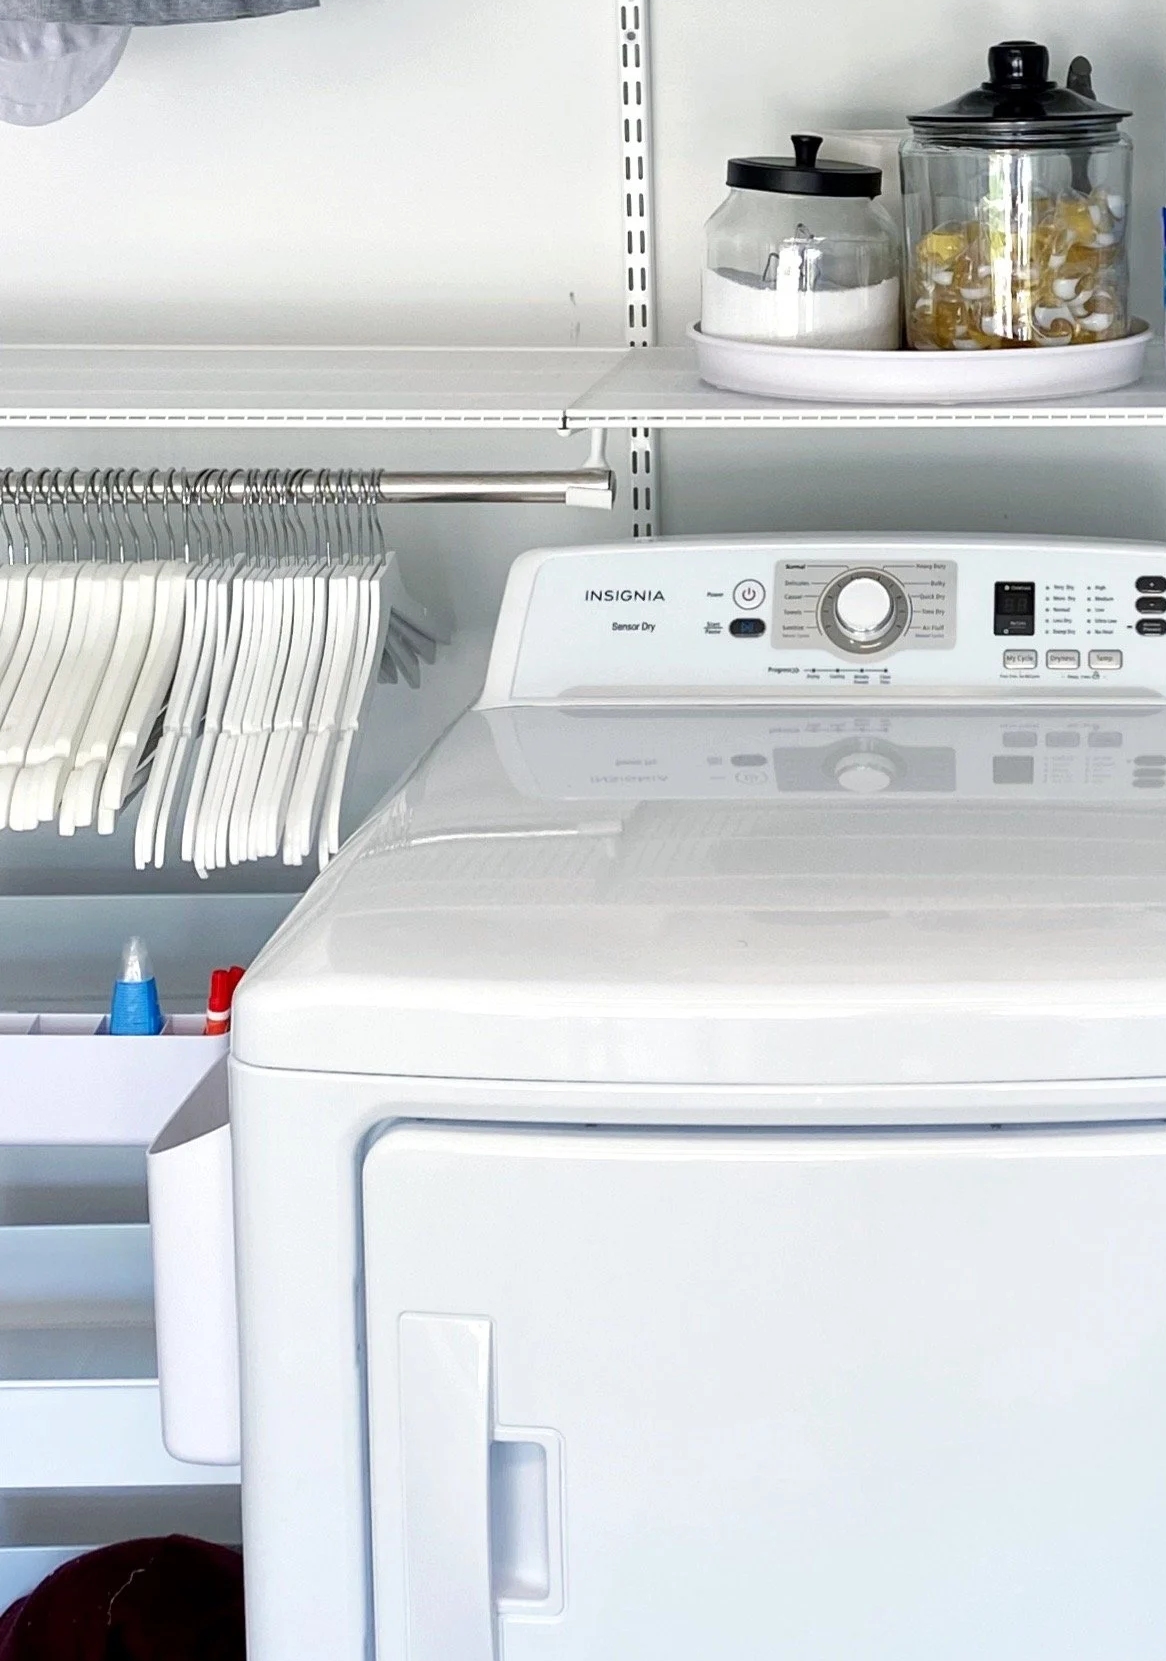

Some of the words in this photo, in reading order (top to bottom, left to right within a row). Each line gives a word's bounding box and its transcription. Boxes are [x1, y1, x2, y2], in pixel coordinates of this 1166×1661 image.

[585, 590, 665, 602] INSIGNIA
[612, 622, 639, 631] Sensor
[641, 621, 656, 633] Dry
[1017, 654, 1034, 662] Cycle
